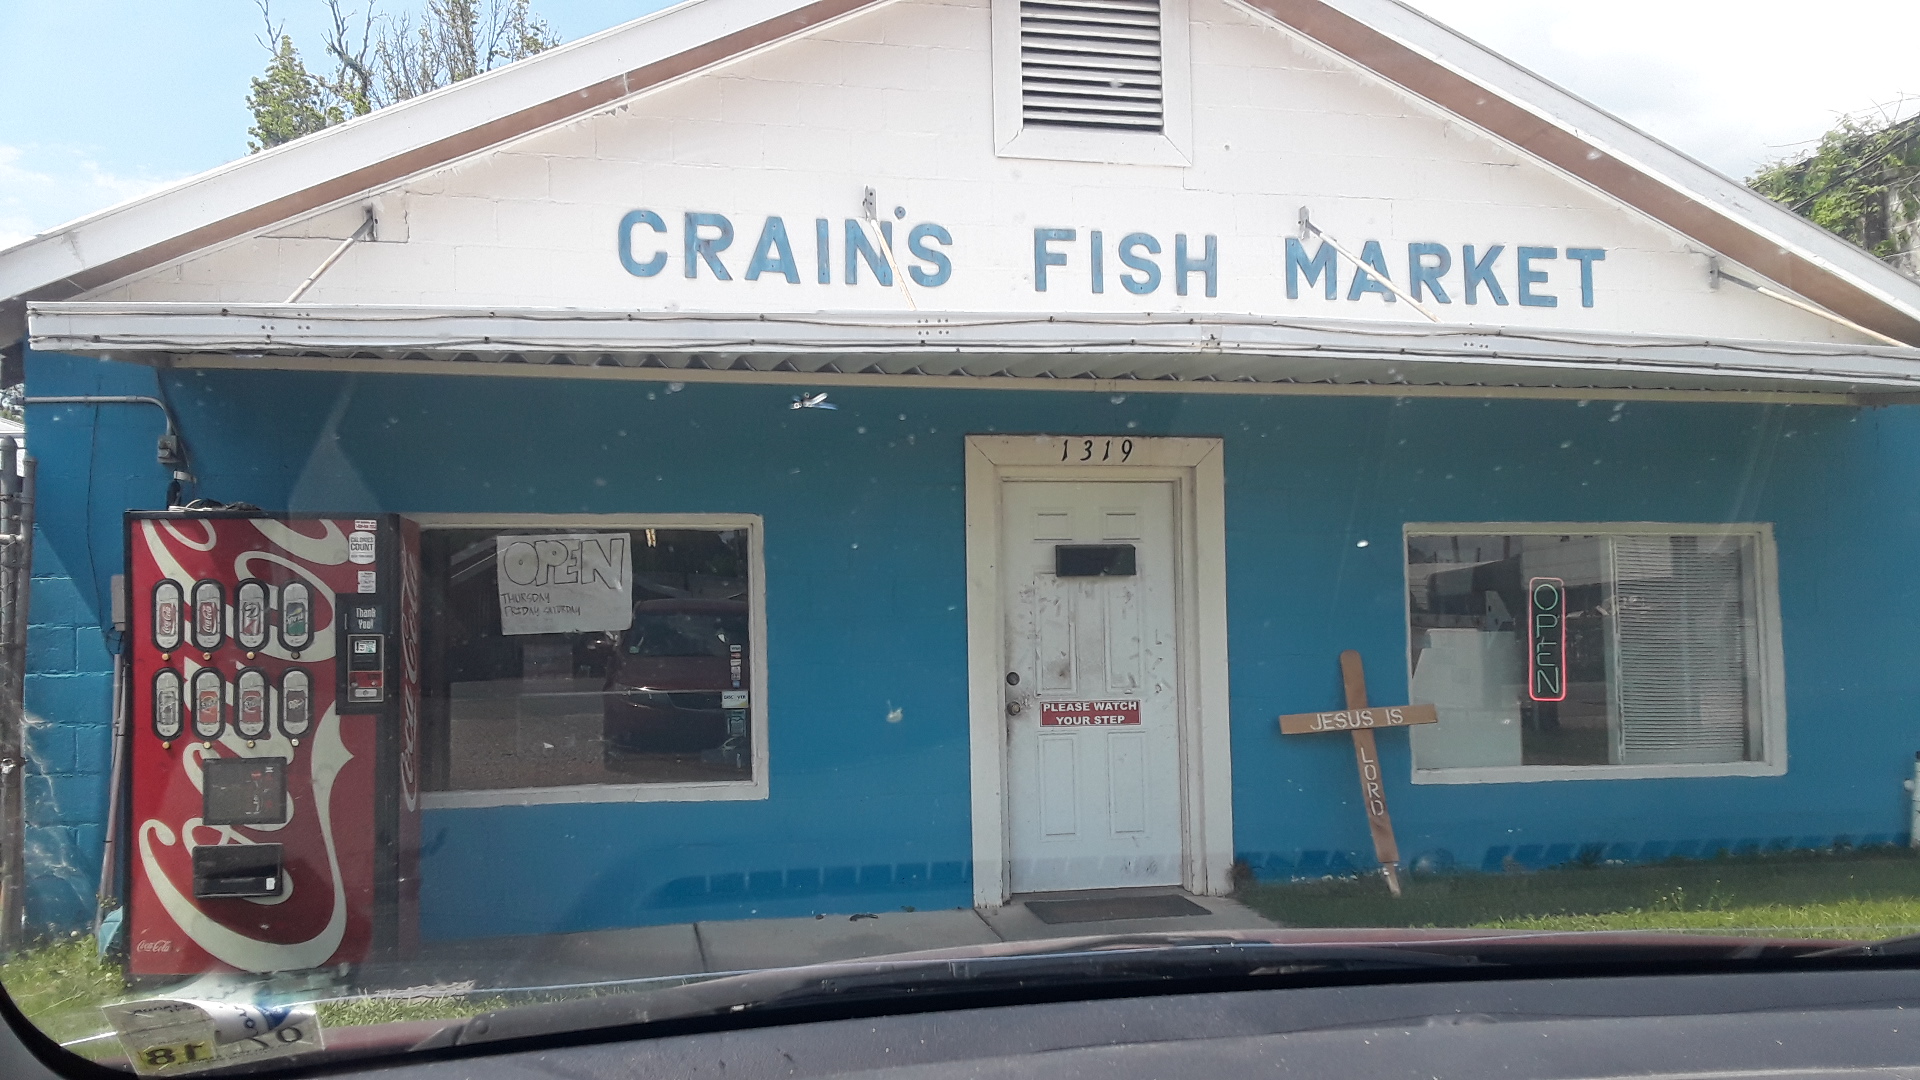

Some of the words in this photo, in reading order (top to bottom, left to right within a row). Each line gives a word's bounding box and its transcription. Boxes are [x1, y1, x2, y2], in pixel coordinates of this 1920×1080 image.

[618, 206, 954, 288] CRAIN'S
[1034, 227, 1218, 298] FISH
[1285, 236, 1609, 309] MARKET
[1061, 439, 1133, 463] 1319
[350, 543, 374, 551] COUNT
[503, 537, 625, 590] OPEN
[501, 592, 550, 604] THURSDAY
[356, 607, 376, 618] Thank
[505, 606, 540, 617] FRIDAY
[1533, 583, 1560, 694] OPEN
[1043, 702, 1090, 712] PLEASE
[1093, 701, 1137, 711] WATCH
[1055, 716, 1091, 725] YOUR
[1094, 715, 1126, 725] STEP
[1310, 710, 1374, 731] JESUS
[1385, 708, 1404, 725] IS
[1360, 747, 1385, 816] LORD
